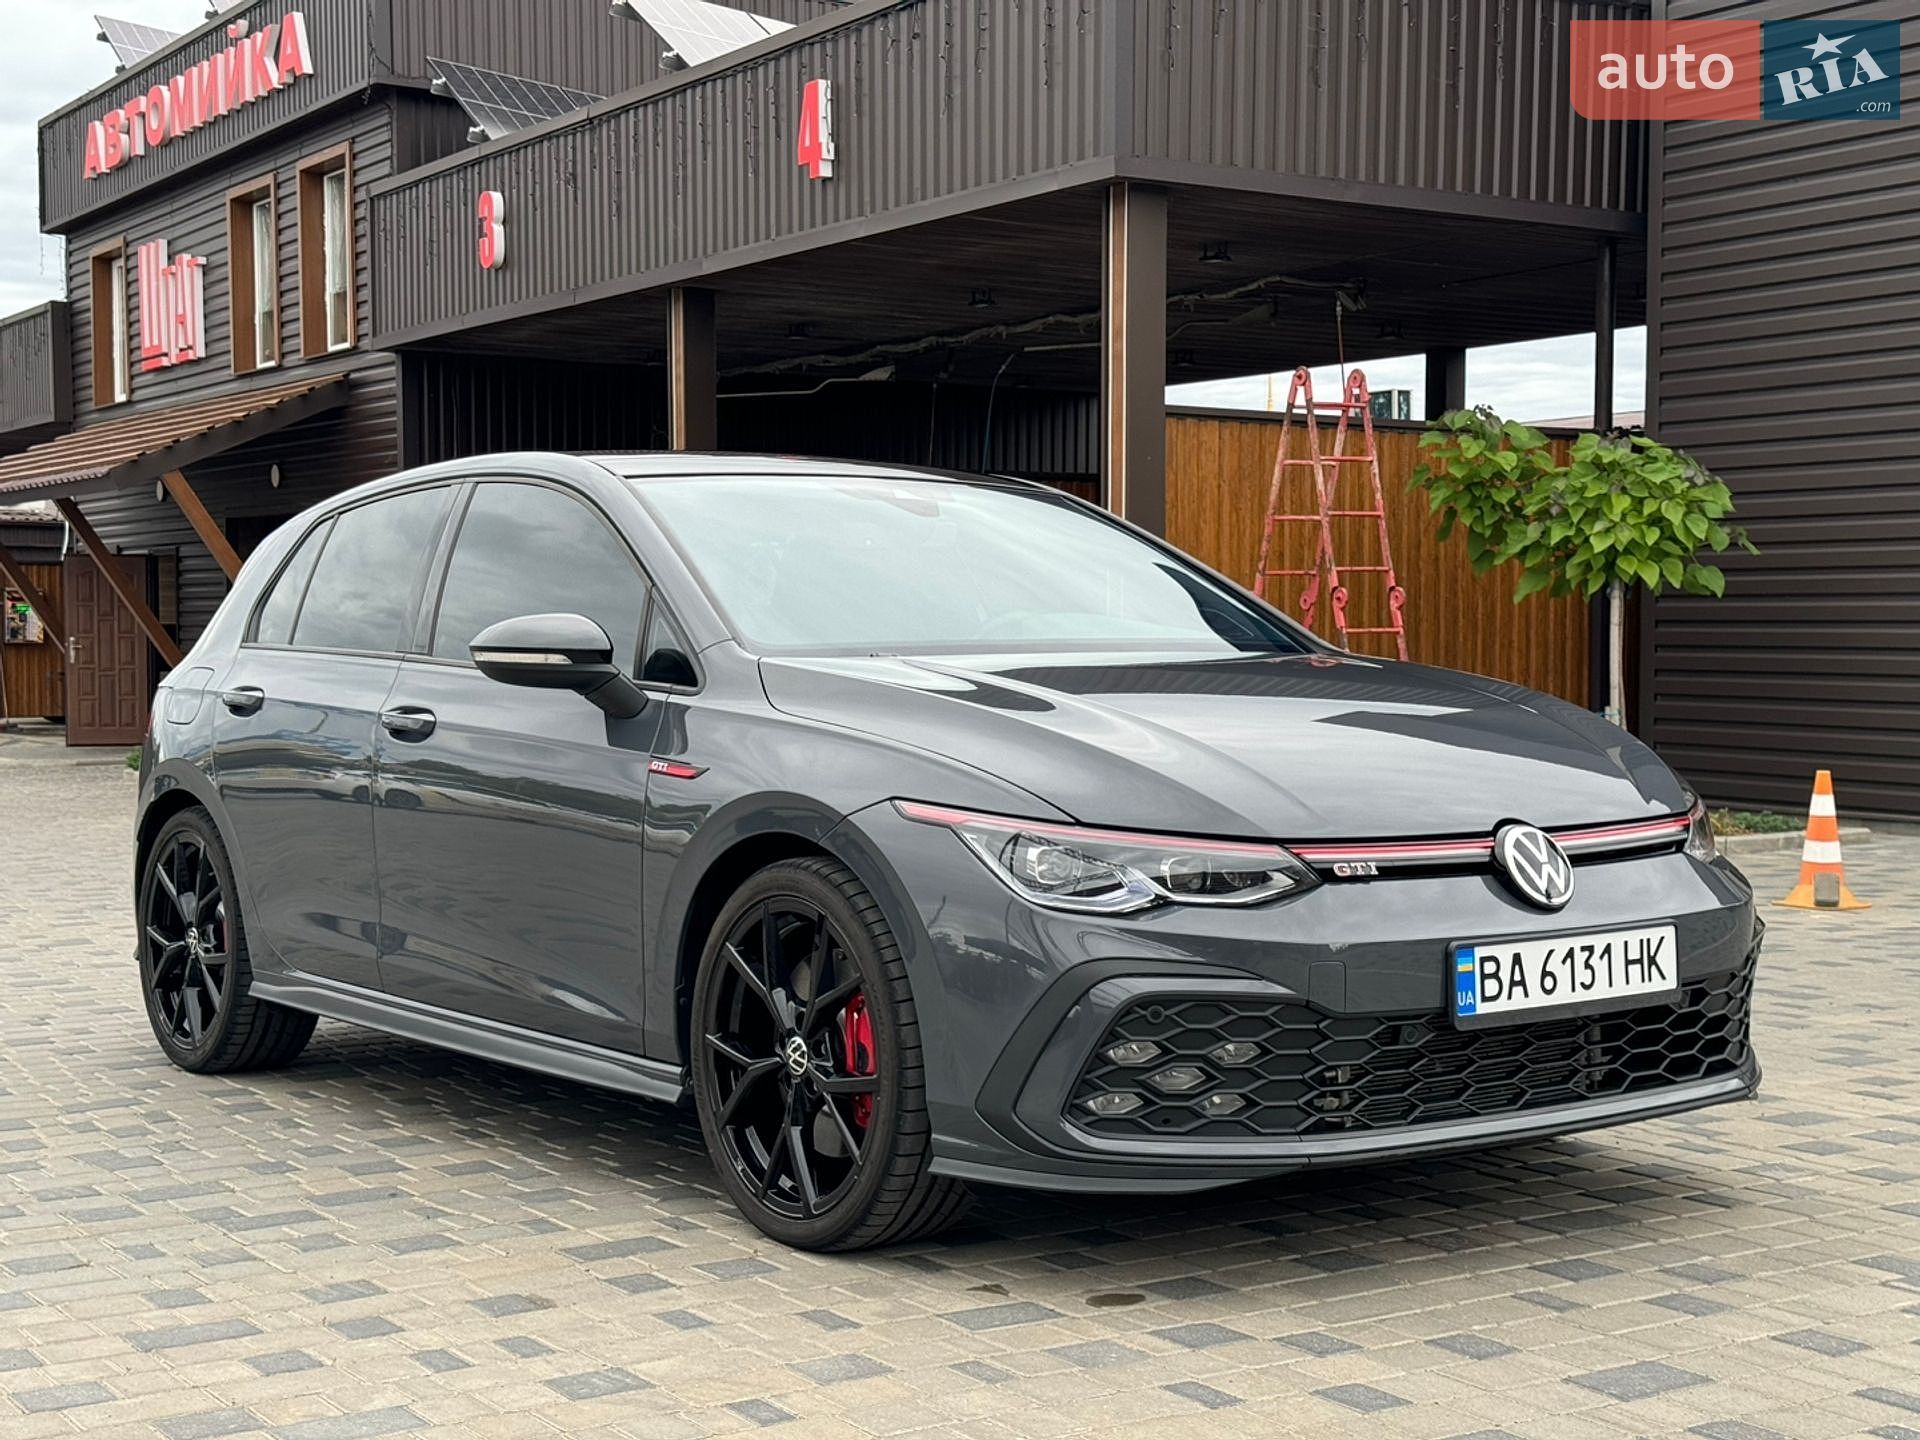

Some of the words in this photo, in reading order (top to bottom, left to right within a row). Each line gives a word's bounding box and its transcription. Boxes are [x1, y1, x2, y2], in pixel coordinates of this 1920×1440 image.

[84, 11, 314, 180] АВТОМИЙКА
[797, 79, 834, 180] 4
[478, 190, 505, 270] 3
[1333, 862, 1379, 877] GTI
[1457, 991, 1475, 1006] UA
[1479, 953, 1529, 1003] BA
[1540, 942, 1614, 996] 6131
